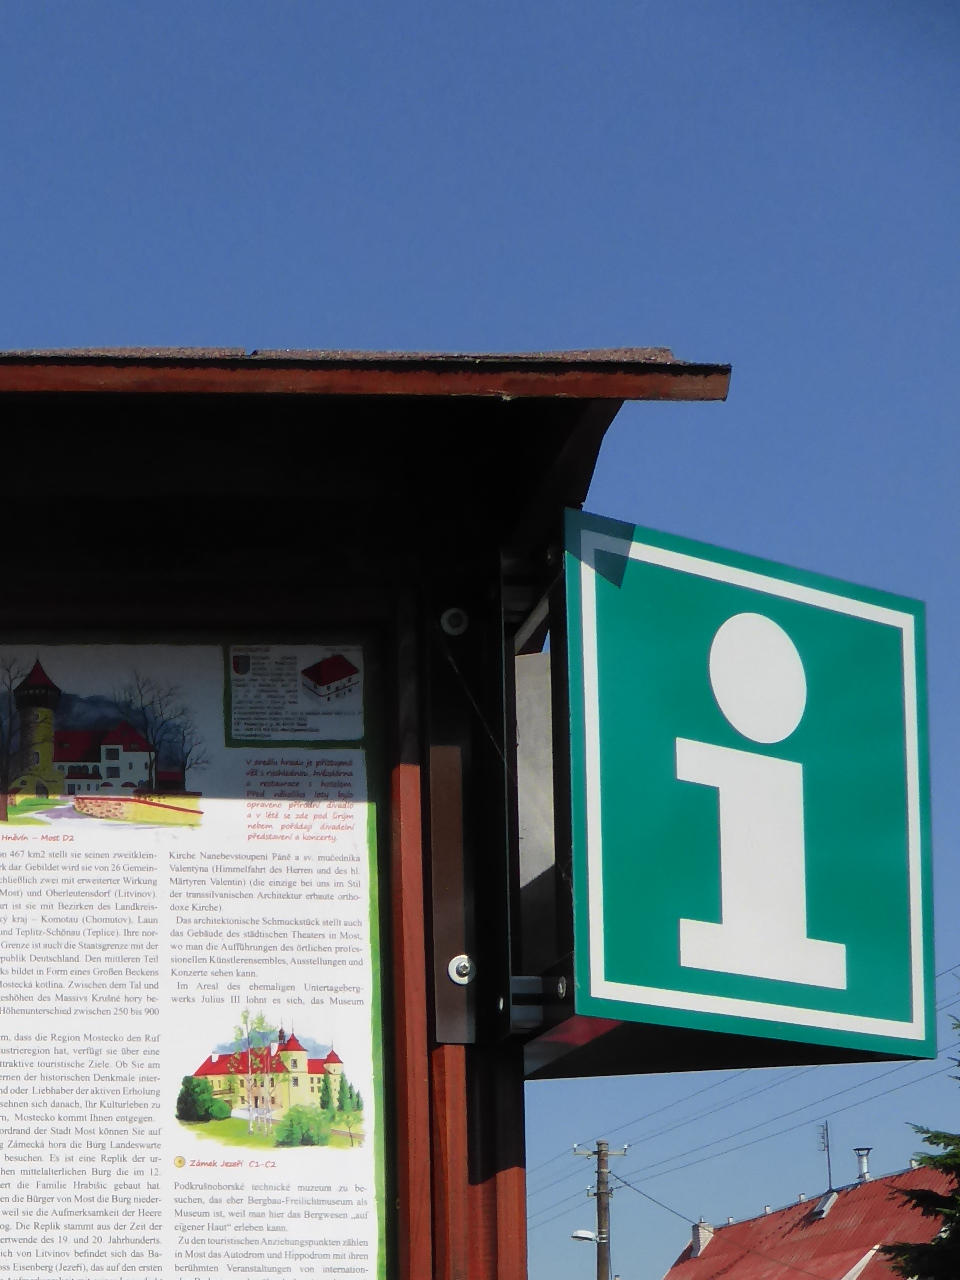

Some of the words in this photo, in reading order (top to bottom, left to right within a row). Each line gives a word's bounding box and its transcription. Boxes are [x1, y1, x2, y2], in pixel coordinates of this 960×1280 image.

[246, 802, 282, 810] opraveno
[288, 800, 320, 810] přírodní
[326, 800, 354, 810] divadlo
[675, 612, 847, 990] i
[265, 811, 279, 819] létě
[295, 812, 309, 820] zde
[312, 812, 328, 821] pod
[332, 812, 354, 822] širým
[247, 821, 273, 830] nebem
[280, 822, 312, 832] pořádají
[320, 820, 355, 831] divadelní
[1, 833, 29, 841] Hněvín
[40, 834, 60, 842] Most
[62, 834, 74, 842] D2
[247, 832, 293, 842] představení
[302, 833, 338, 843] koncerty.
[29, 954, 82, 963] Deutschland.
[85, 954, 102, 963] Den
[104, 954, 141, 963] mittleren
[143, 954, 159, 963] Teil
[14, 1033, 32, 1041] dass
[34, 1033, 48, 1042] die
[50, 1033, 80, 1044] Region
[83, 1033, 124, 1042] Mostecko
[126, 1034, 142, 1042] den
[144, 1034, 161, 1043] Ruf
[189, 1159, 218, 1167] Zámek
[220, 1160, 244, 1168] Jezeří
[248, 1160, 276, 1168] C1-C2
